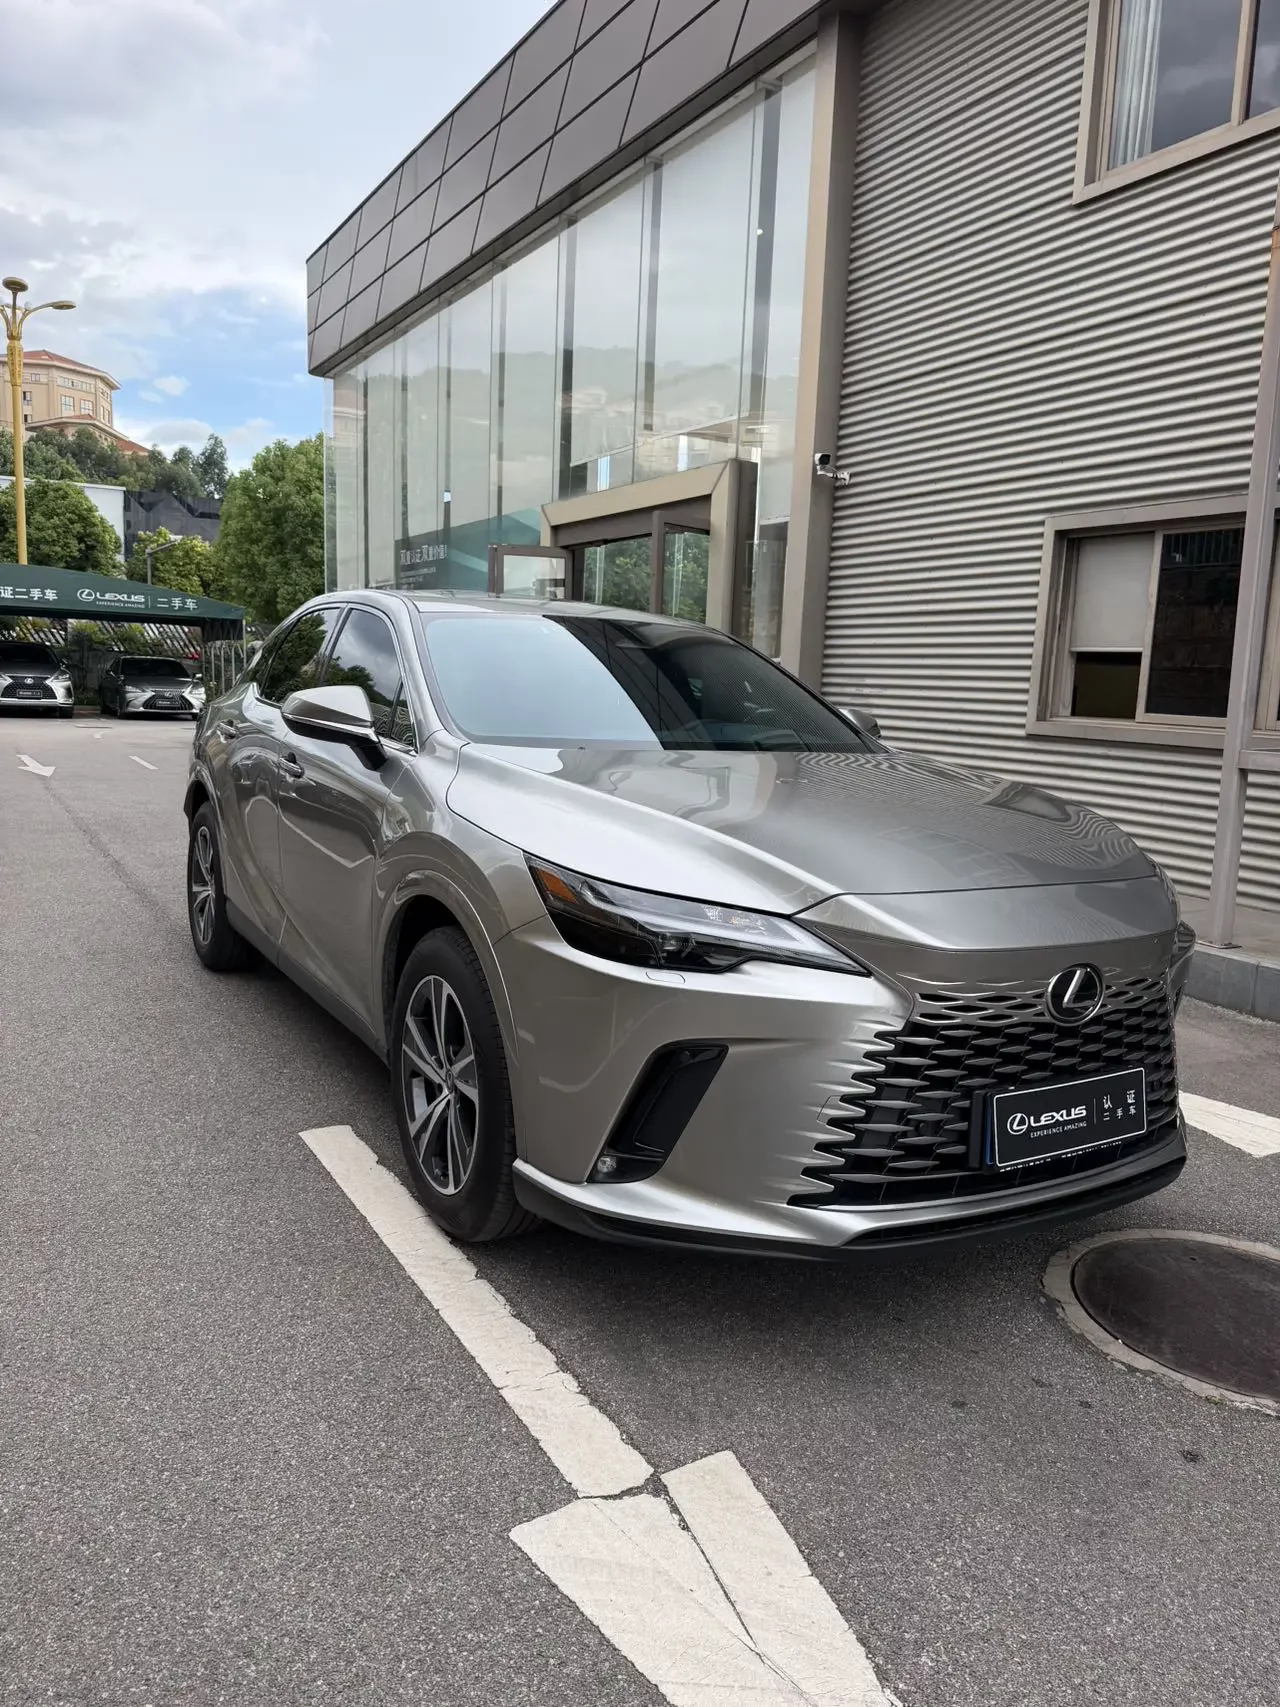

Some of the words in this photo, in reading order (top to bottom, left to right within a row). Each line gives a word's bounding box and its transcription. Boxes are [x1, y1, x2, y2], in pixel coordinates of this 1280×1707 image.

[0, 586, 58, 601] 证二手车
[96, 592, 145, 603] LEXUS
[157, 597, 198, 611] 二手车
[1030, 1105, 1088, 1127] LEXUS
[1103, 1105, 1136, 1121] 二手车
[1030, 1126, 1063, 1138] EXPERIENCE
[1064, 1121, 1088, 1132] AMAZING
